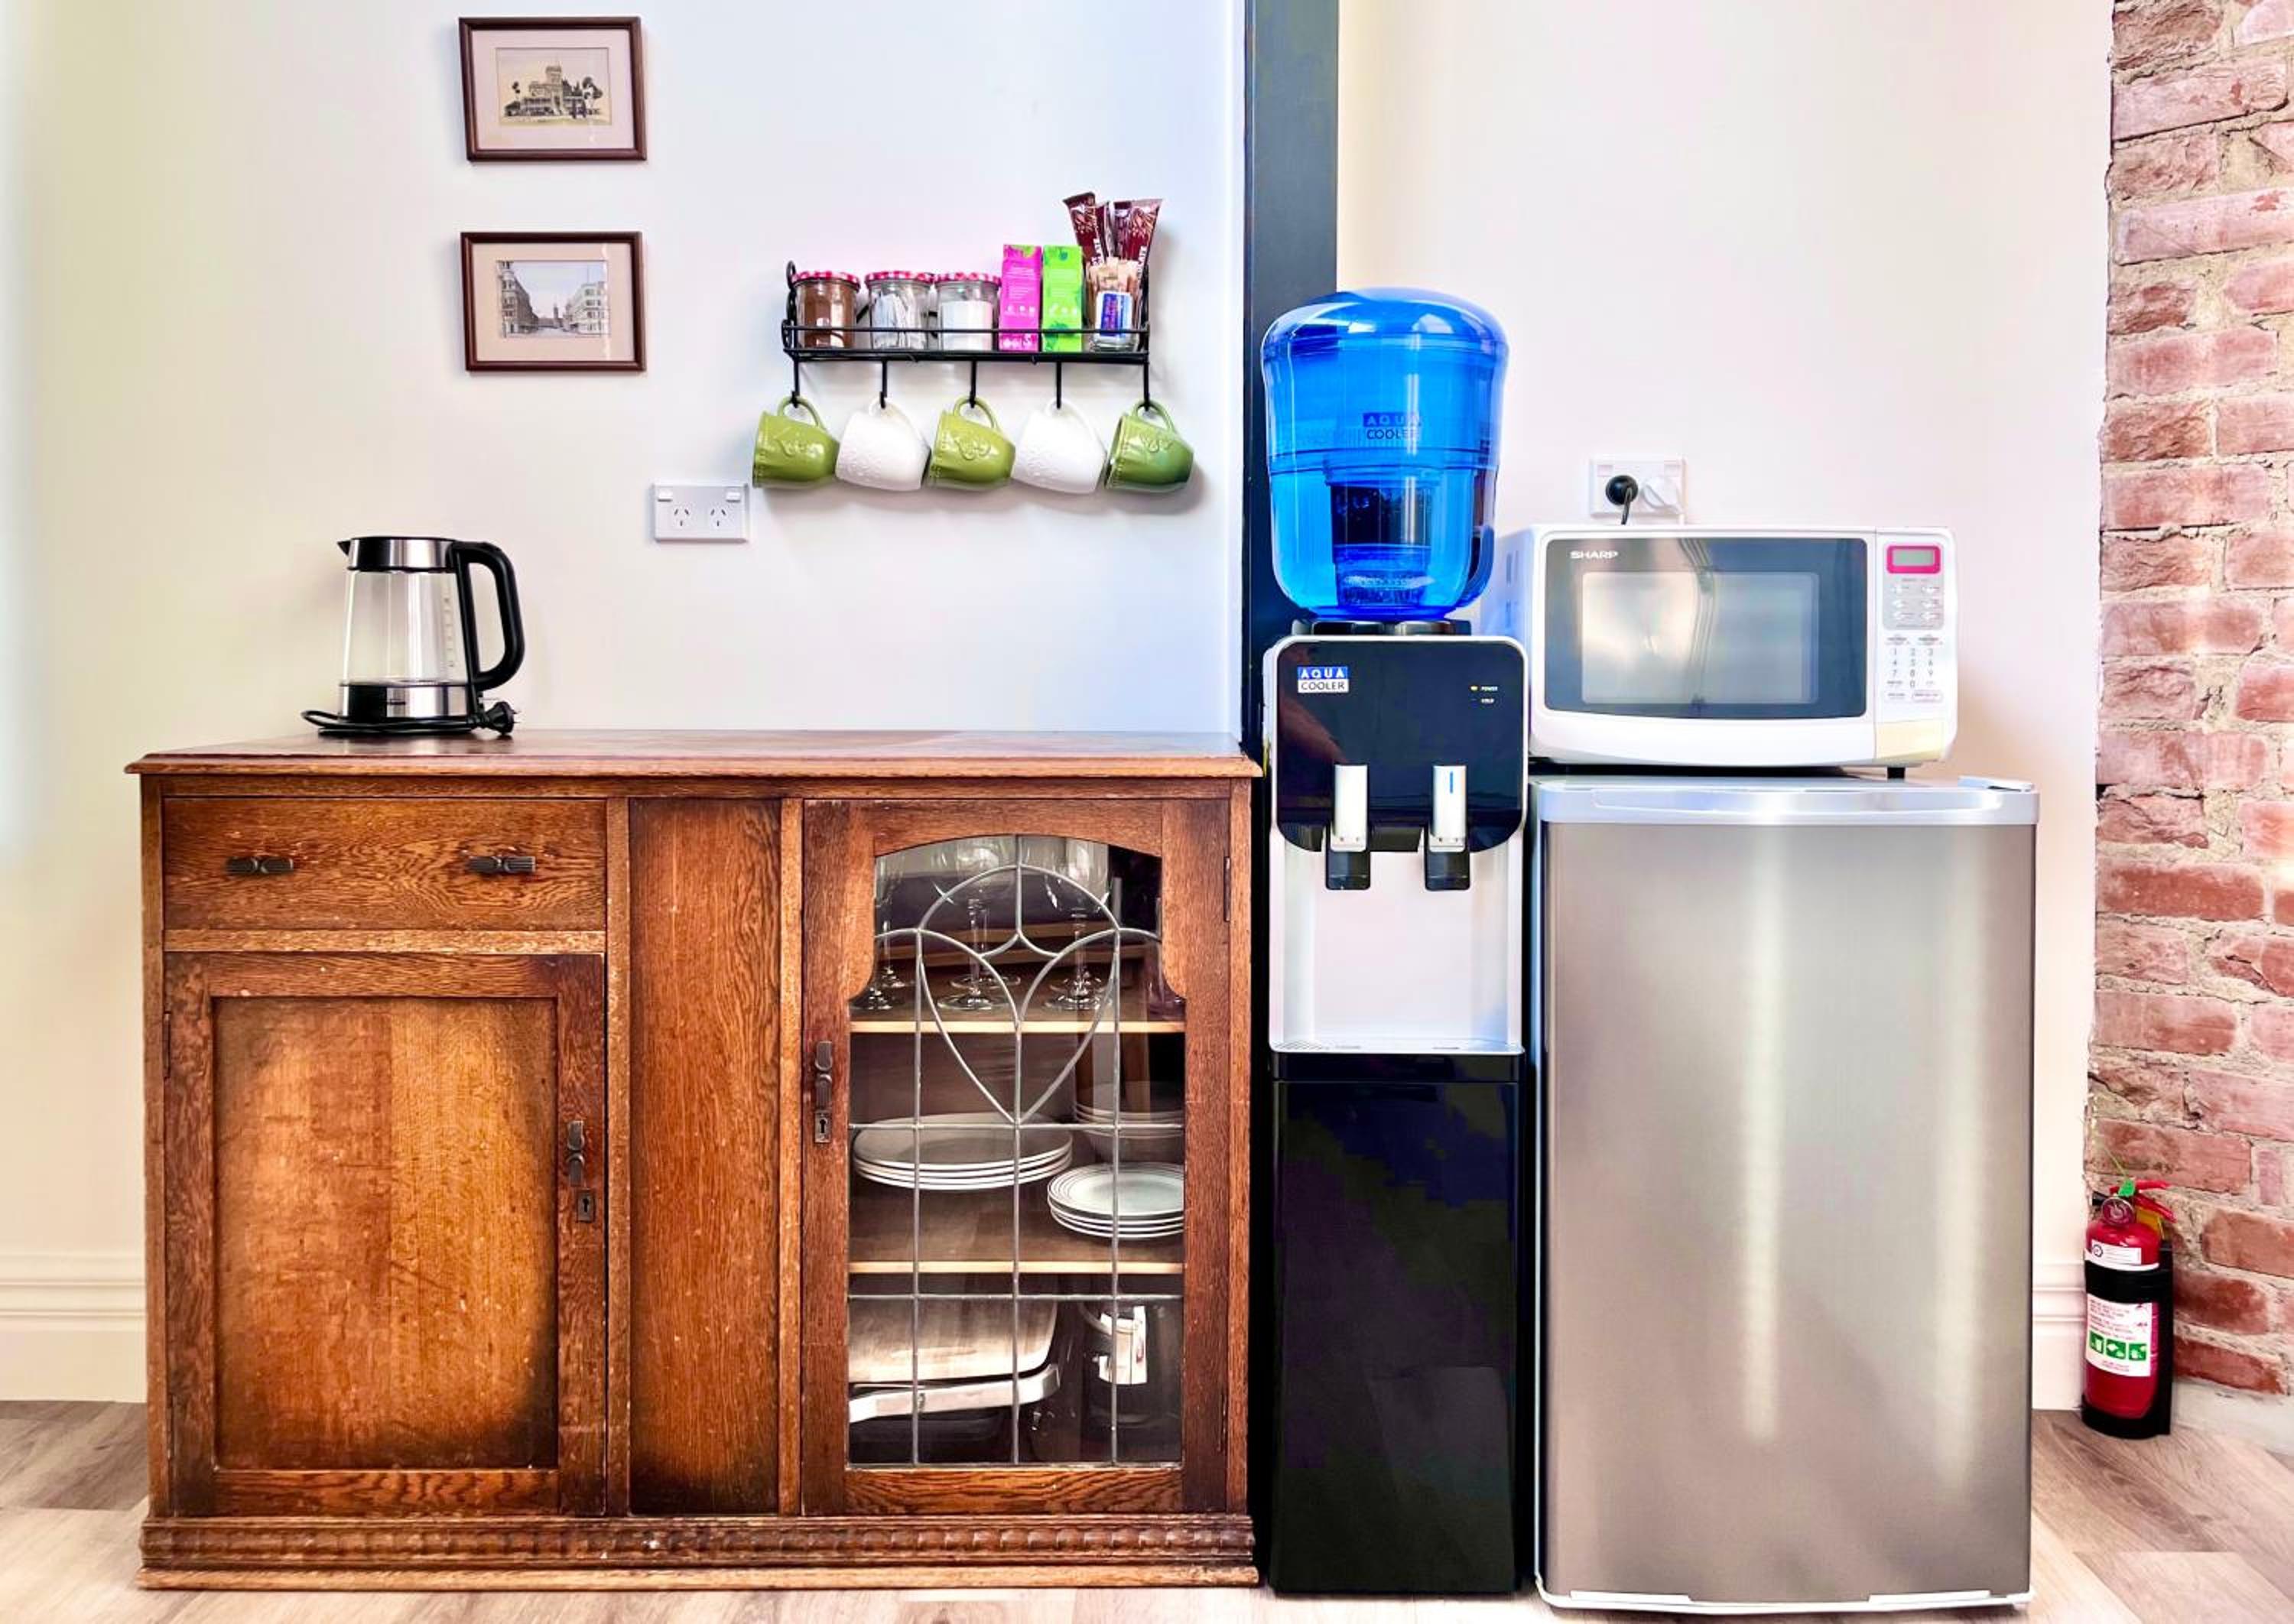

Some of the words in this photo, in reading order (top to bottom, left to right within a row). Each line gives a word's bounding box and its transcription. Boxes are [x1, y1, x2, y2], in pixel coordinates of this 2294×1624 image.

[1571, 551, 1618, 559] SHARP
[1301, 667, 1345, 679] AQUA
[1301, 681, 1345, 690] COOLER
